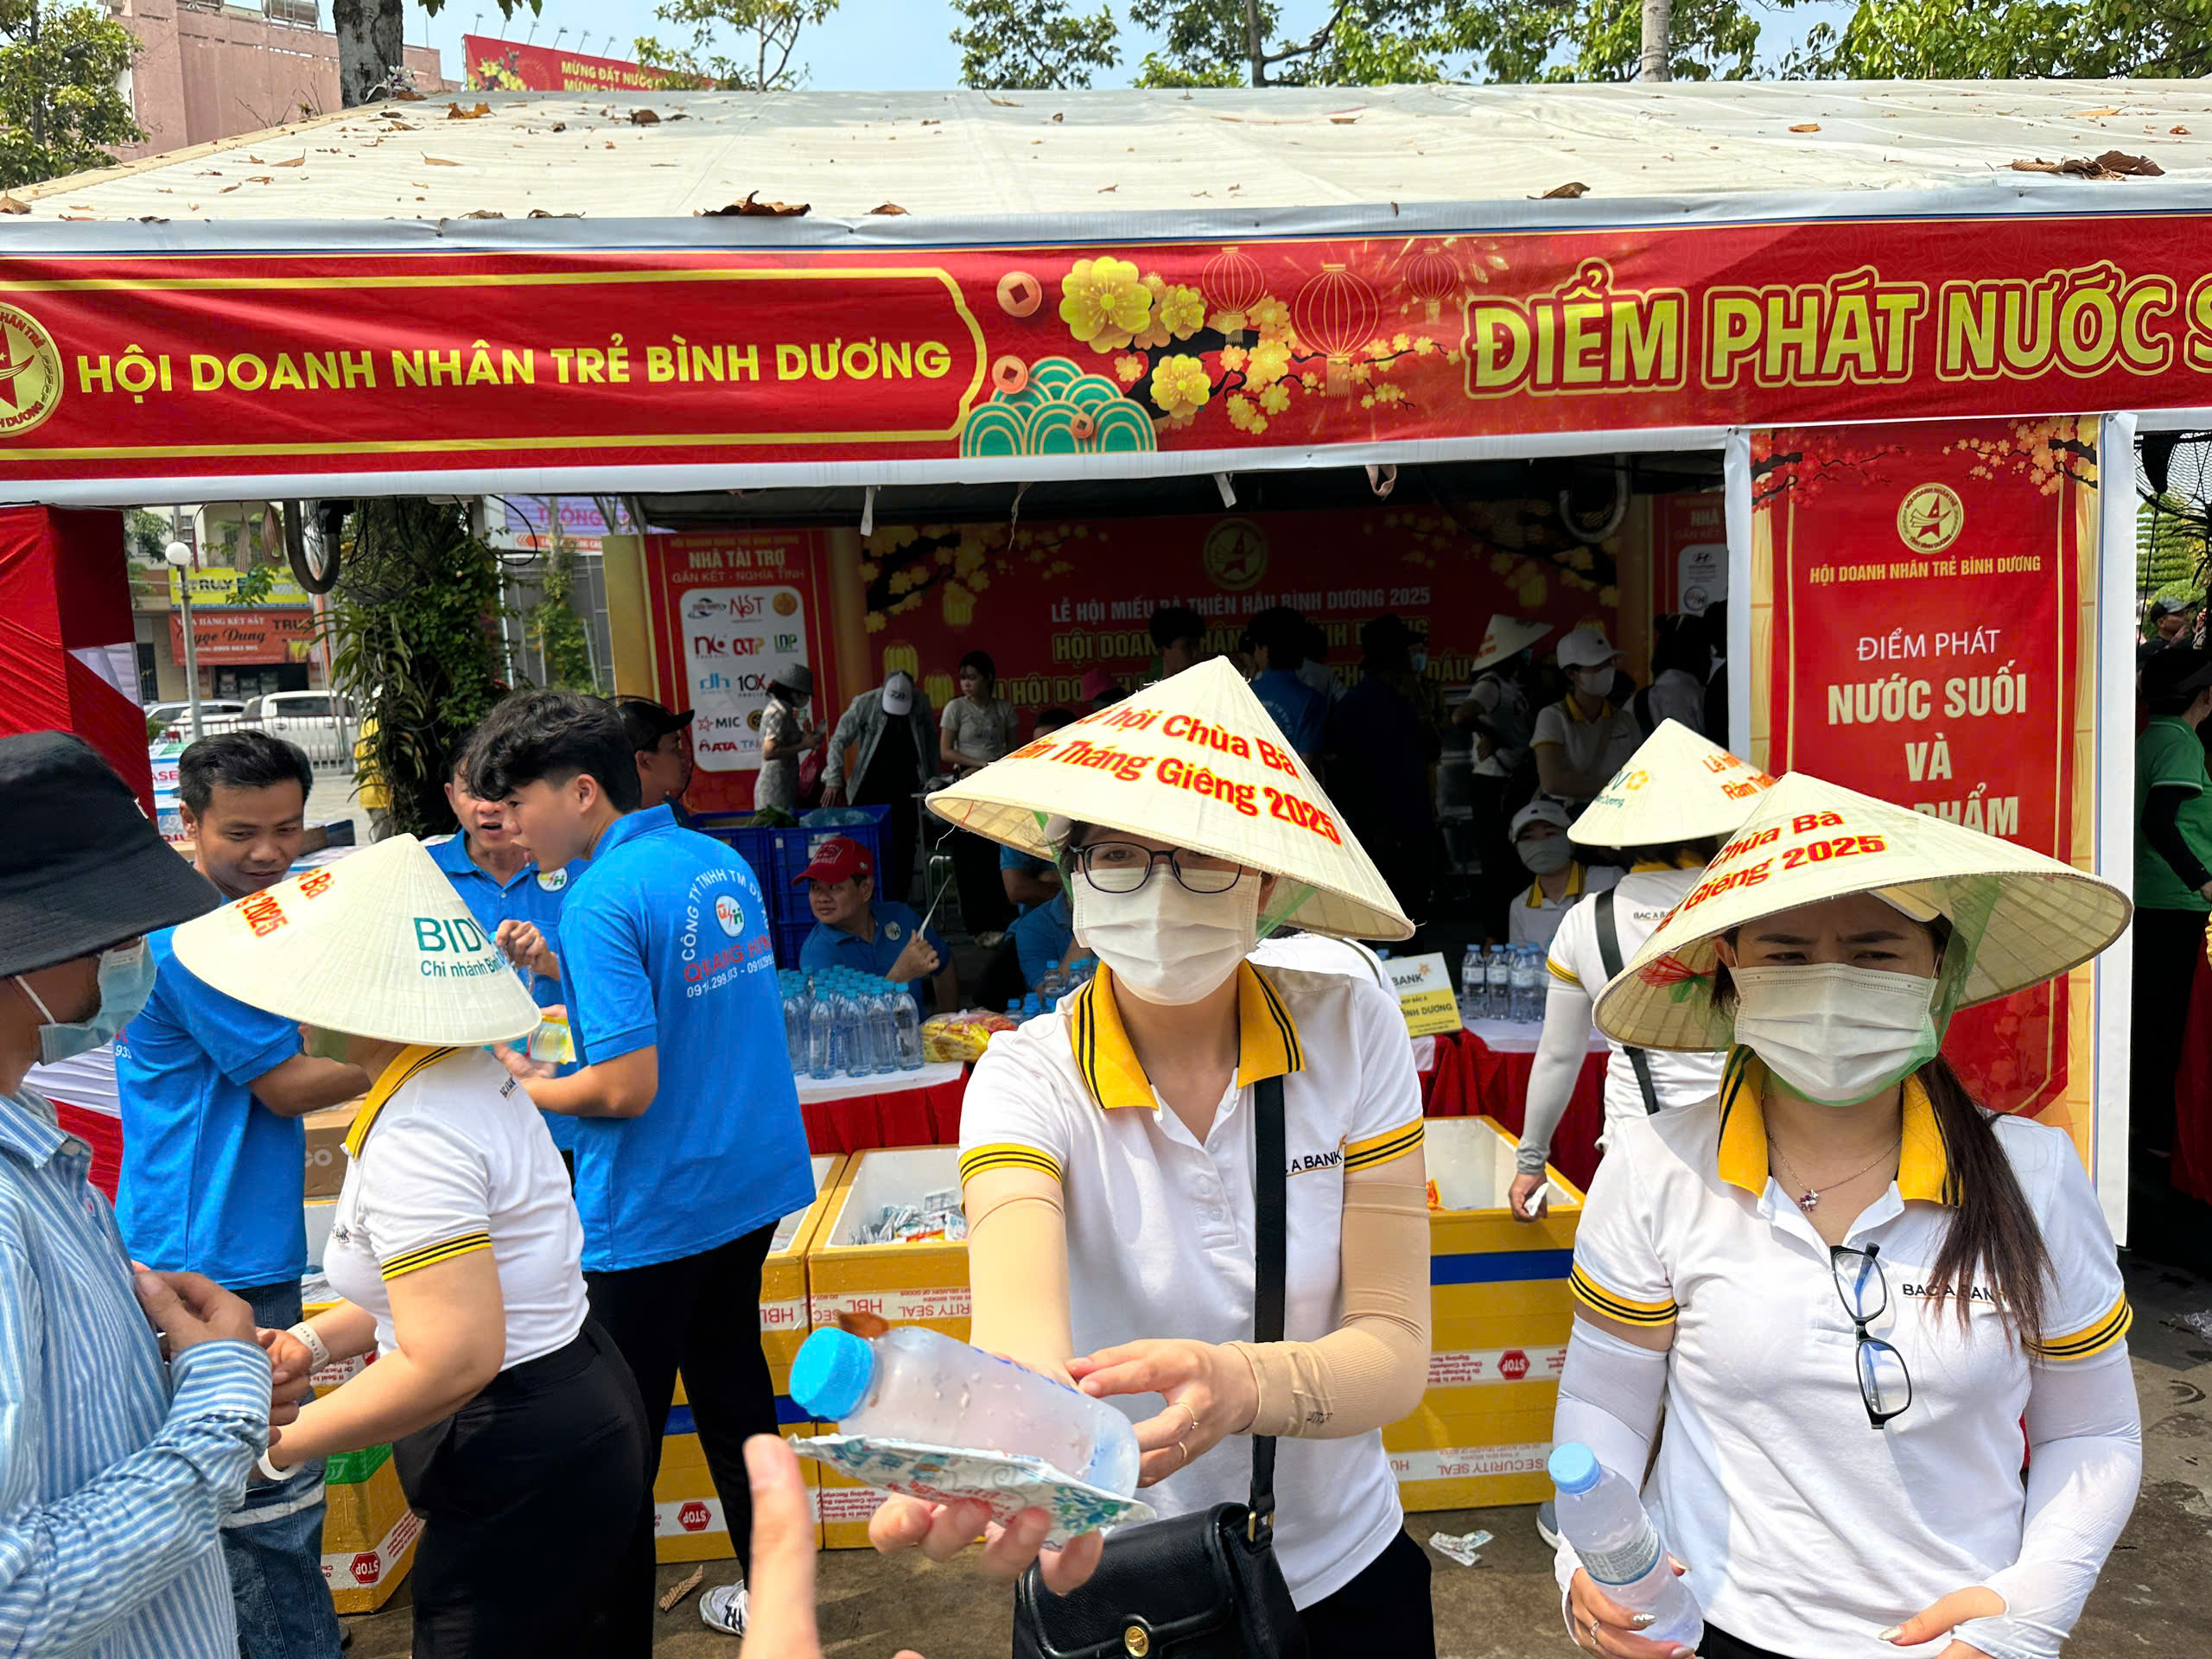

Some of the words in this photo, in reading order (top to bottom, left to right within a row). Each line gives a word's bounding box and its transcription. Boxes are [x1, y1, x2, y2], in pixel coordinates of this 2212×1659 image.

[1467, 261, 1686, 394] ĐIỂM
[1706, 269, 1926, 386] PHÁT
[1938, 264, 2171, 375] NƯỚC
[77, 344, 173, 404] HỘI
[189, 350, 377, 391] DOANH
[391, 339, 535, 388] NHÂN
[550, 333, 631, 384] TRẺ
[646, 334, 760, 383] BÌNH
[776, 337, 951, 380] DƯƠNG
[1809, 566, 1835, 586] HỘI
[1839, 564, 1886, 582] DOANH
[1890, 558, 1929, 580] NHÂN
[1933, 553, 1956, 577] TRẺ
[1958, 556, 1994, 576] BÌNH
[1998, 553, 2041, 574] DƯƠNG
[1326, 588, 1383, 609] DƯƠNG
[1389, 587, 1431, 607] 2025
[1053, 630, 1095, 666] HỘI
[1856, 627, 1926, 662] ĐIỂM
[1936, 626, 2000, 656] PHÁT
[1827, 671, 1931, 725] NƯỚC
[1944, 658, 2026, 718] SUỐI
[1163, 714, 1253, 760] Chùa
[1255, 736, 1301, 779] Bà
[1905, 732, 1952, 782] VÀ
[1050, 740, 1155, 782] Tháng
[1157, 757, 1260, 817] Giêng
[1262, 786, 1343, 846] 2025
[1792, 810, 1845, 836] Bà
[695, 868, 728, 889] TNHH
[728, 868, 747, 888] TM
[1683, 857, 1775, 912] Giêng
[1782, 834, 1887, 872] 2025
[690, 883, 702, 904] TY
[680, 905, 700, 962] CÔNG
[421, 959, 447, 978] Chi
[450, 959, 489, 978] nhánh
[1291, 1159, 1302, 1173] A
[1303, 1150, 1343, 1169] BANK
[760, 1306, 794, 1324] HBL
[899, 1305, 934, 1318] SEAL
[1502, 1358, 1526, 1372] STOP
[1436, 1463, 1471, 1476] SEAL
[1471, 1458, 1545, 1474] SECURITY
[682, 1509, 708, 1524] STOP
[354, 1559, 379, 1576] STOP
